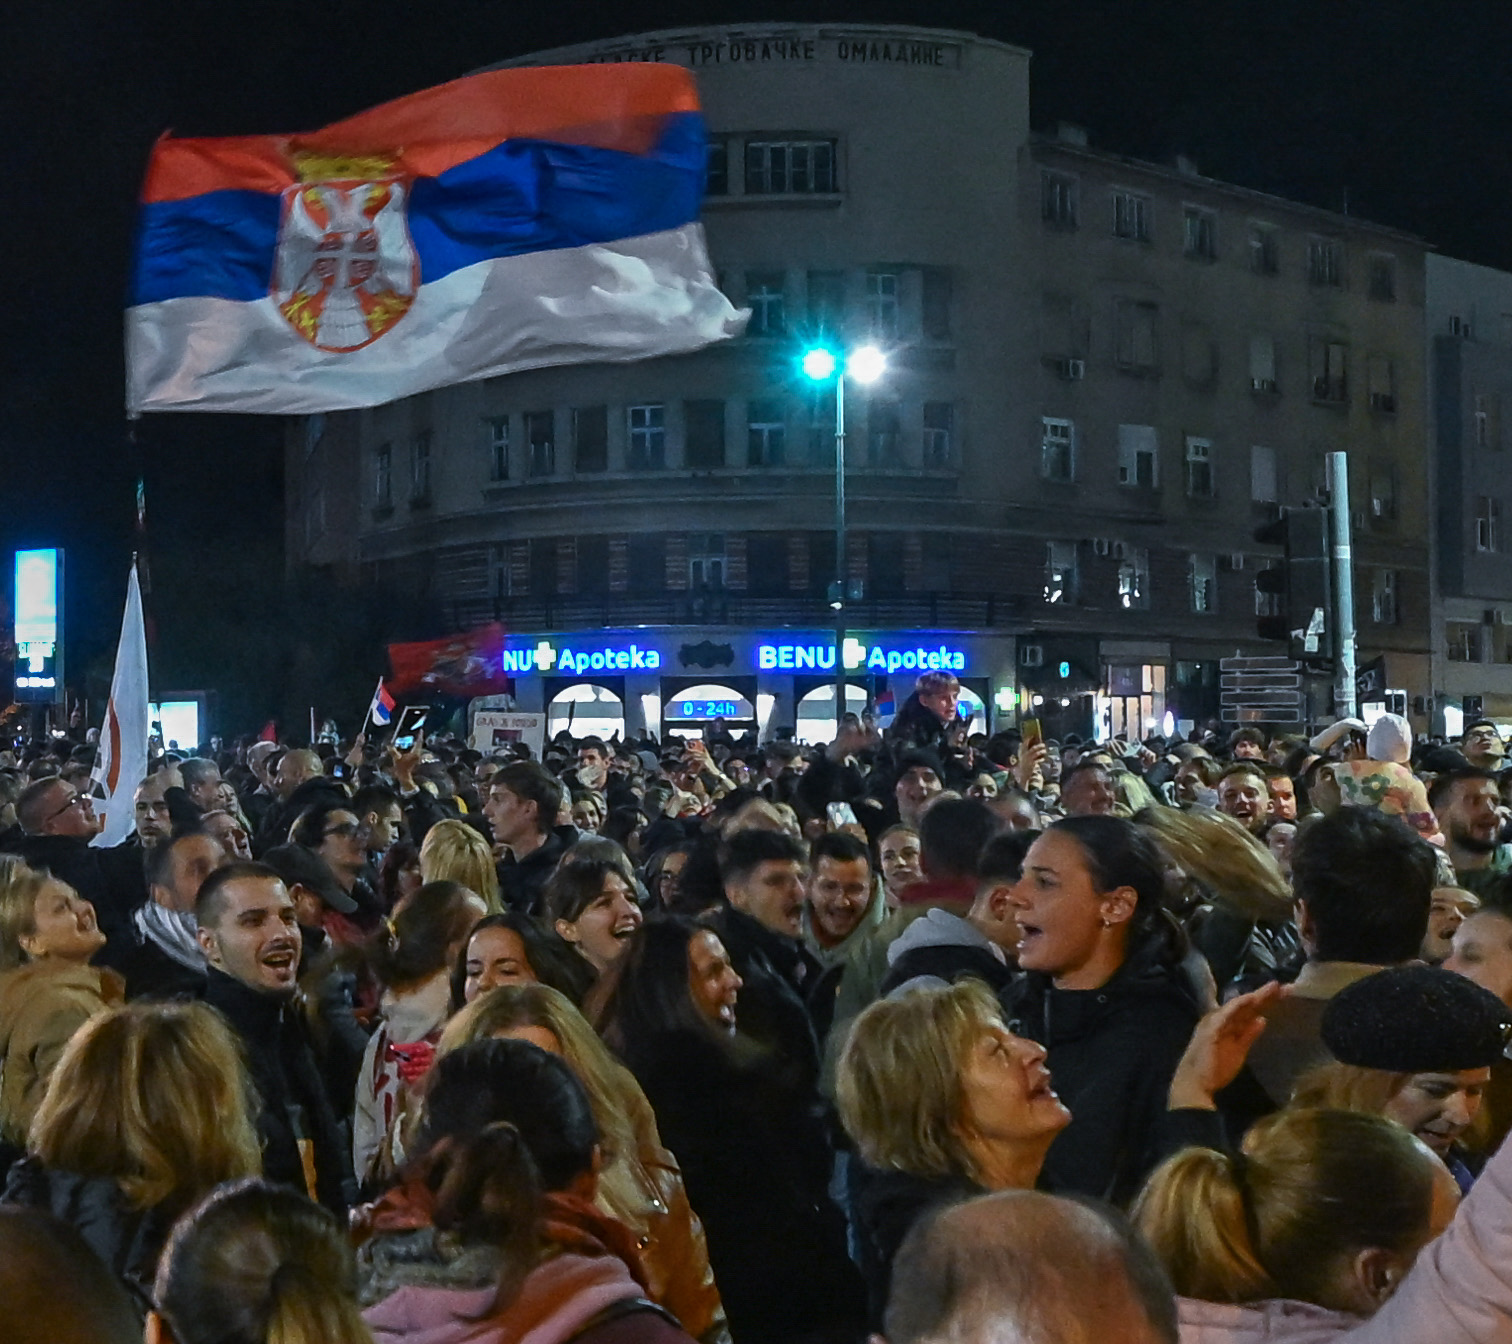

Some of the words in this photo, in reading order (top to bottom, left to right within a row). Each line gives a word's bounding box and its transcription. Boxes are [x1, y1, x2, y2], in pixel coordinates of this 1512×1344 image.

[687, 40, 815, 66] ТРГОВАЧКЕ
[837, 41, 944, 67] ОМЛАДИНЕ
[558, 645, 660, 675] Apoteka
[758, 645, 836, 669] BENU
[867, 645, 965, 674] Apoteka
[705, 701, 735, 716] 24h
